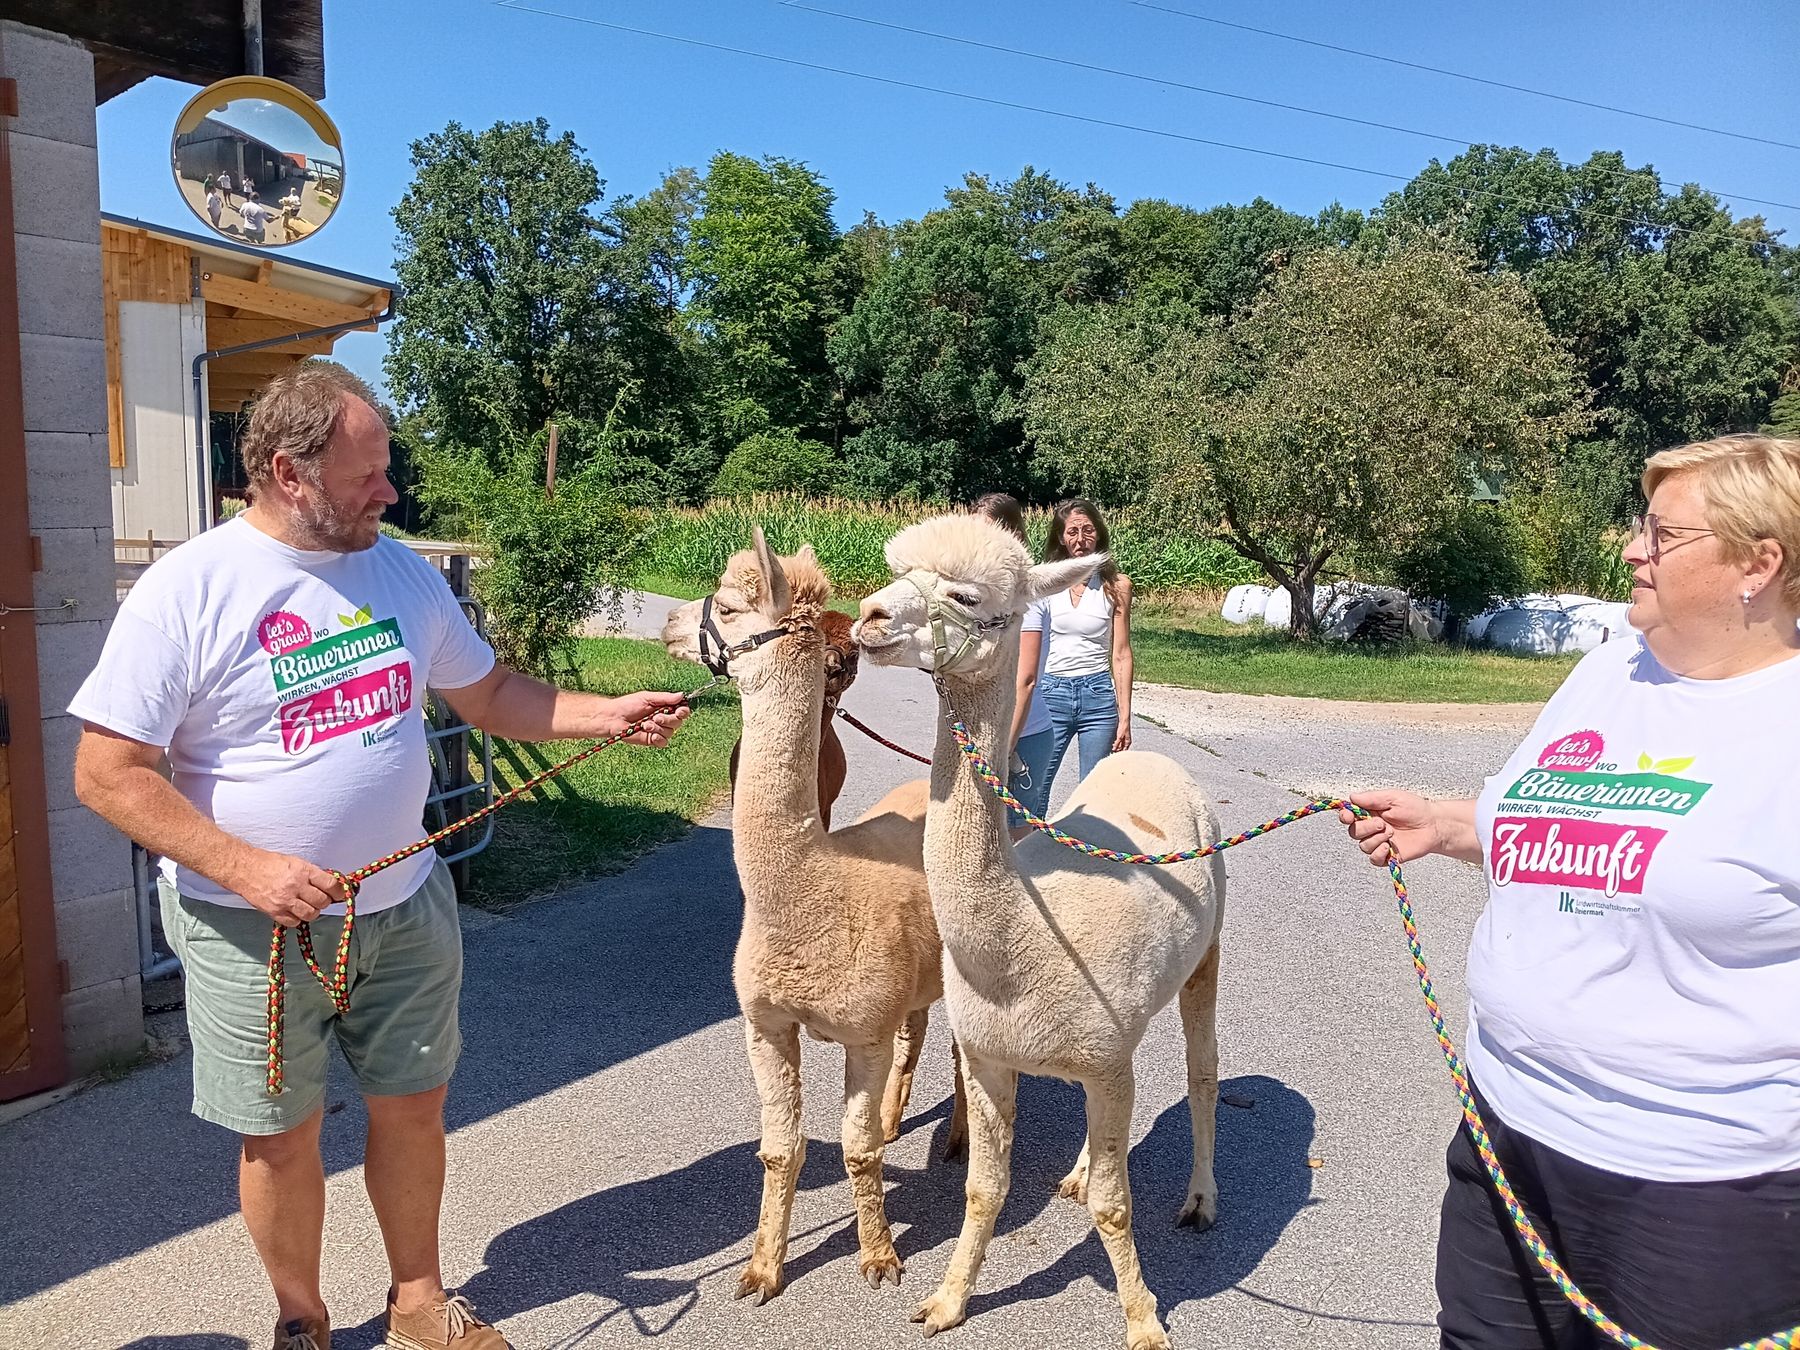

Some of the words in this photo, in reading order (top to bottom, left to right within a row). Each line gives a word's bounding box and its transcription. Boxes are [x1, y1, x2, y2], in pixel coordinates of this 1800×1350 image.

[266, 619, 294, 639] let's
[270, 626, 310, 656] grow!
[314, 628, 330, 639] WO
[274, 629, 399, 685] Bäuerinnen
[278, 682, 321, 703] WIRKEN,
[321, 666, 359, 687] WÄCHST
[284, 669, 409, 755] Zukunft
[1555, 738, 1591, 754] let's
[1544, 750, 1600, 770] grow!
[1595, 762, 1618, 772] WO
[1517, 771, 1692, 810] Bäuerinnen
[1497, 802, 1543, 815] WIRKEN,
[1546, 804, 1602, 819] WÄCHST
[1495, 823, 1645, 899] Zukunft
